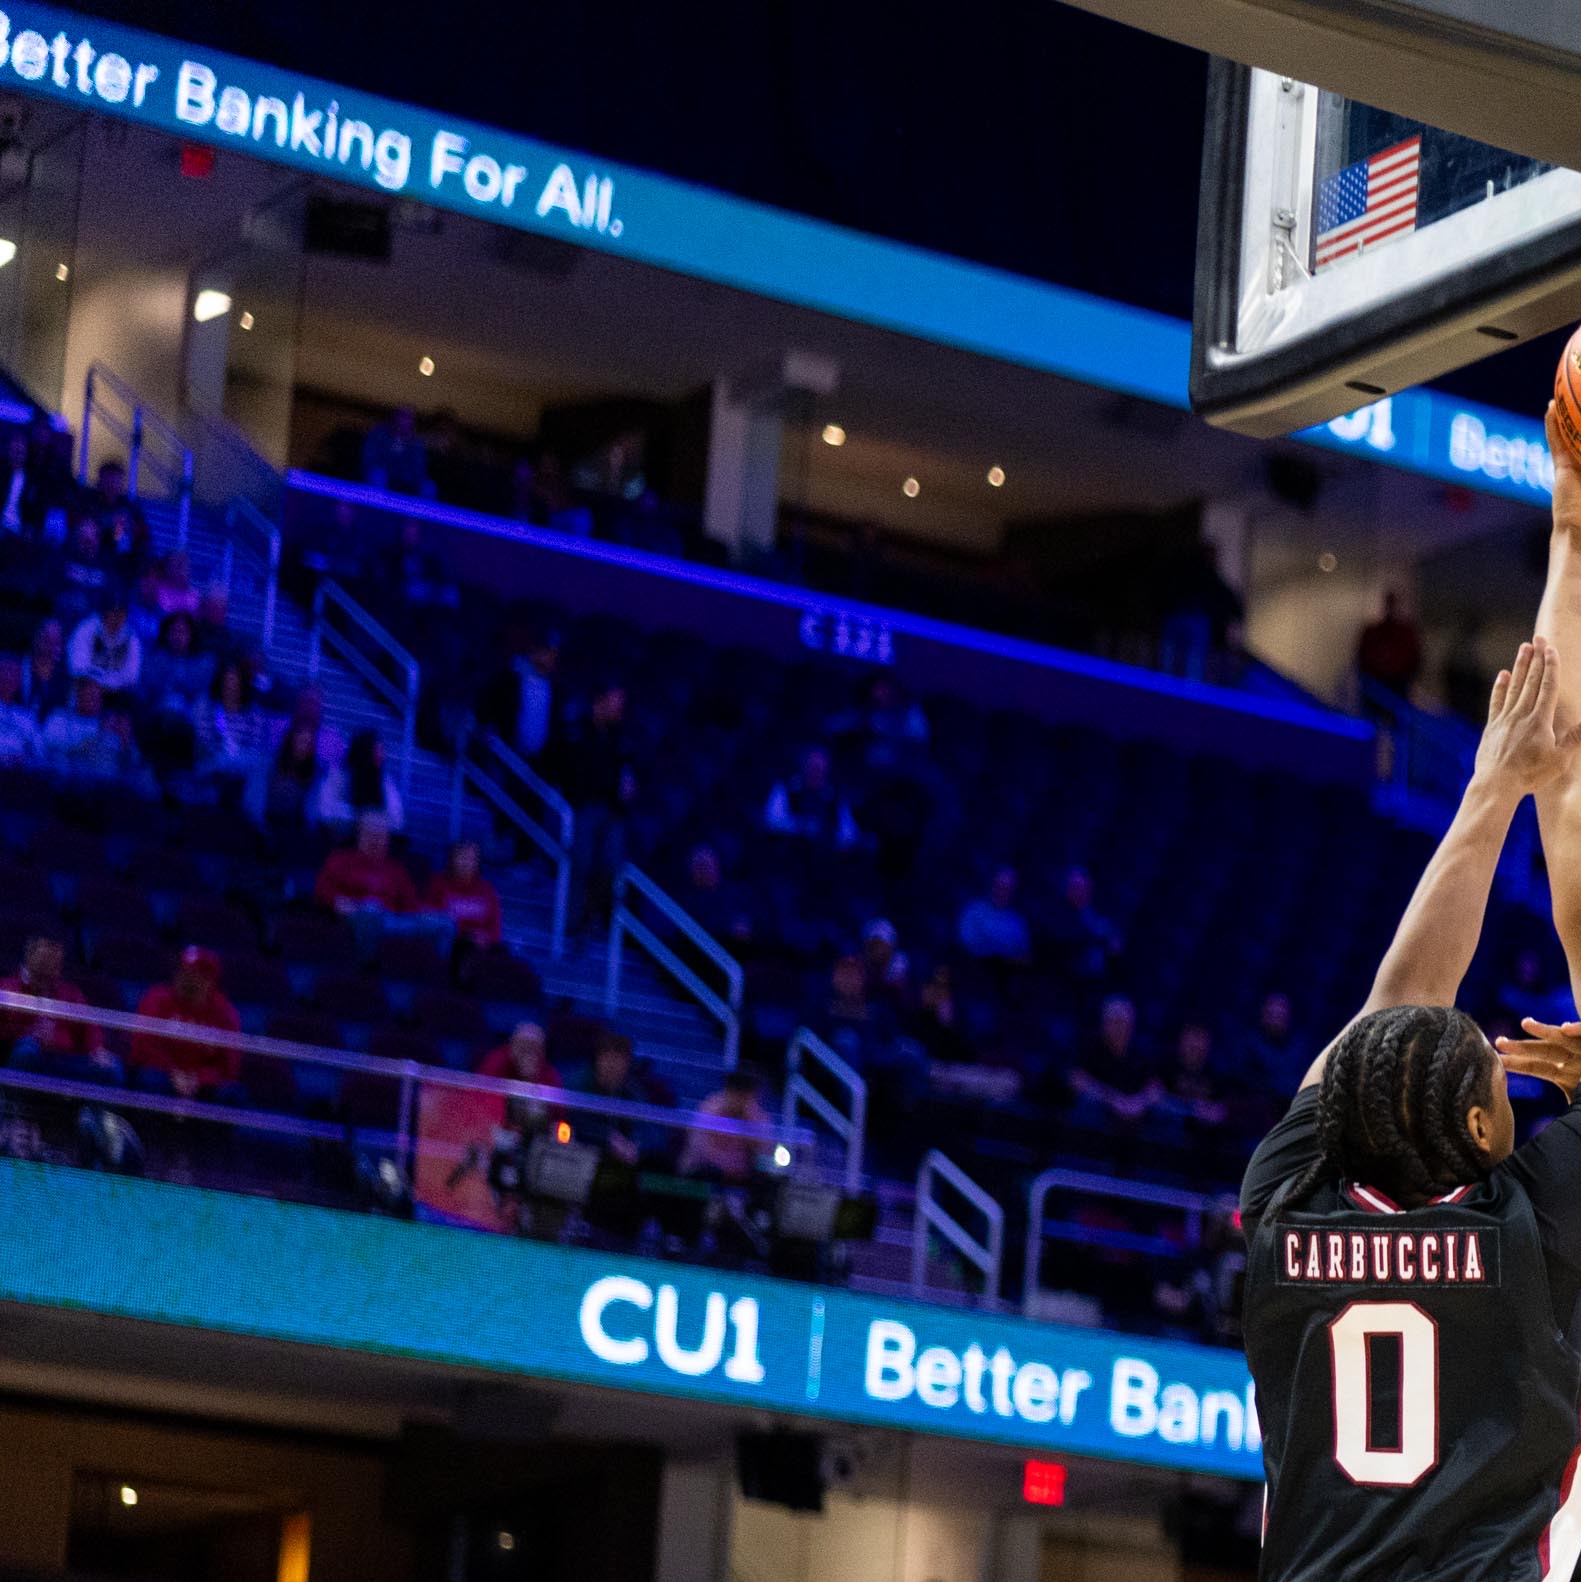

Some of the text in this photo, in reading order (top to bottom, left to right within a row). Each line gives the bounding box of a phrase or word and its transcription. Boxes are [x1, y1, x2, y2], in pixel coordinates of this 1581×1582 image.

[176, 60, 411, 189] Banking
[430, 130, 526, 202] For
[536, 163, 623, 236] All.
[1284, 1229, 1485, 1282] CARBUCCIA
[580, 1276, 764, 1383] CU1
[866, 1318, 1091, 1426] Better
[1328, 1302, 1439, 1486] 0
